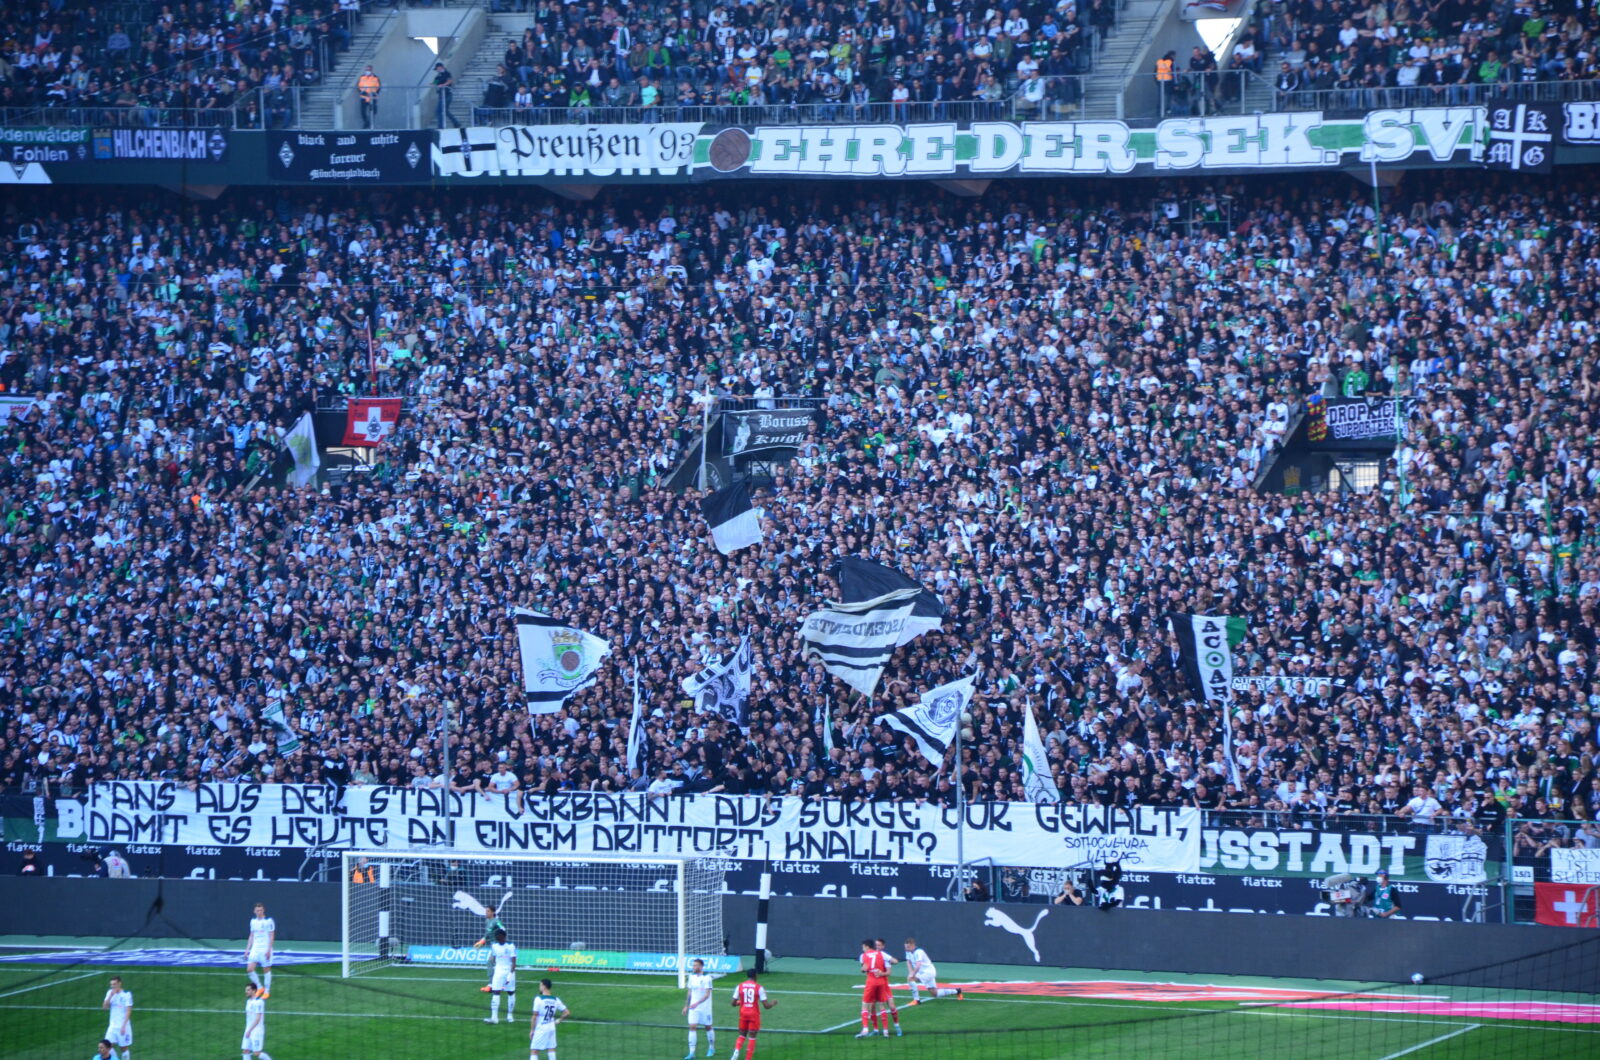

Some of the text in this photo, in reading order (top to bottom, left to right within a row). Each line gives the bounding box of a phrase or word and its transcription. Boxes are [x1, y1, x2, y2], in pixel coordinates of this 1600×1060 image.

[1563, 103, 1600, 143] B
[113, 129, 207, 159] HILCHENBACH
[298, 134, 399, 148] black and white
[499, 127, 641, 164] Preußen
[750, 124, 957, 177] EHRE
[970, 120, 1136, 174] DER
[1154, 111, 1341, 169] SEK.
[13, 146, 69, 161] Fohlen
[330, 153, 366, 165] forever
[310, 168, 380, 180] Münchengladbach
[758, 414, 811, 431] Boruss
[1334, 418, 1396, 439] SUPPORTERS
[91, 782, 176, 811] FANS
[196, 784, 261, 813] AUS
[282, 785, 348, 815] DER
[370, 787, 484, 818] STADT
[504, 790, 695, 823] VERBANNT
[715, 796, 783, 827] AUS
[1035, 804, 1188, 842] GEWALT,
[90, 811, 188, 843] DAMIT
[208, 815, 252, 845] ES
[271, 816, 388, 847] HEUTE
[475, 820, 577, 851] EINEM
[593, 823, 764, 857] DRITTORT
[785, 830, 937, 862] KNALLT?
[6, 842, 43, 852] flatex
[126, 844, 162, 855] flatex
[185, 845, 221, 856] flatex
[245, 847, 281, 857] flatex
[304, 848, 340, 858] flatex
[695, 860, 742, 872] flatex
[772, 861, 820, 873] flatex
[849, 863, 899, 876] flatex
[928, 865, 978, 878] flatex
[1567, 860, 1594, 872] IST
[1175, 873, 1216, 885] flatex
[1241, 876, 1282, 888] flatex
[1446, 884, 1489, 896] flatex
[868, 954, 878, 969] 7
[743, 988, 755, 1004] 19
[543, 1005, 556, 1022] 25
